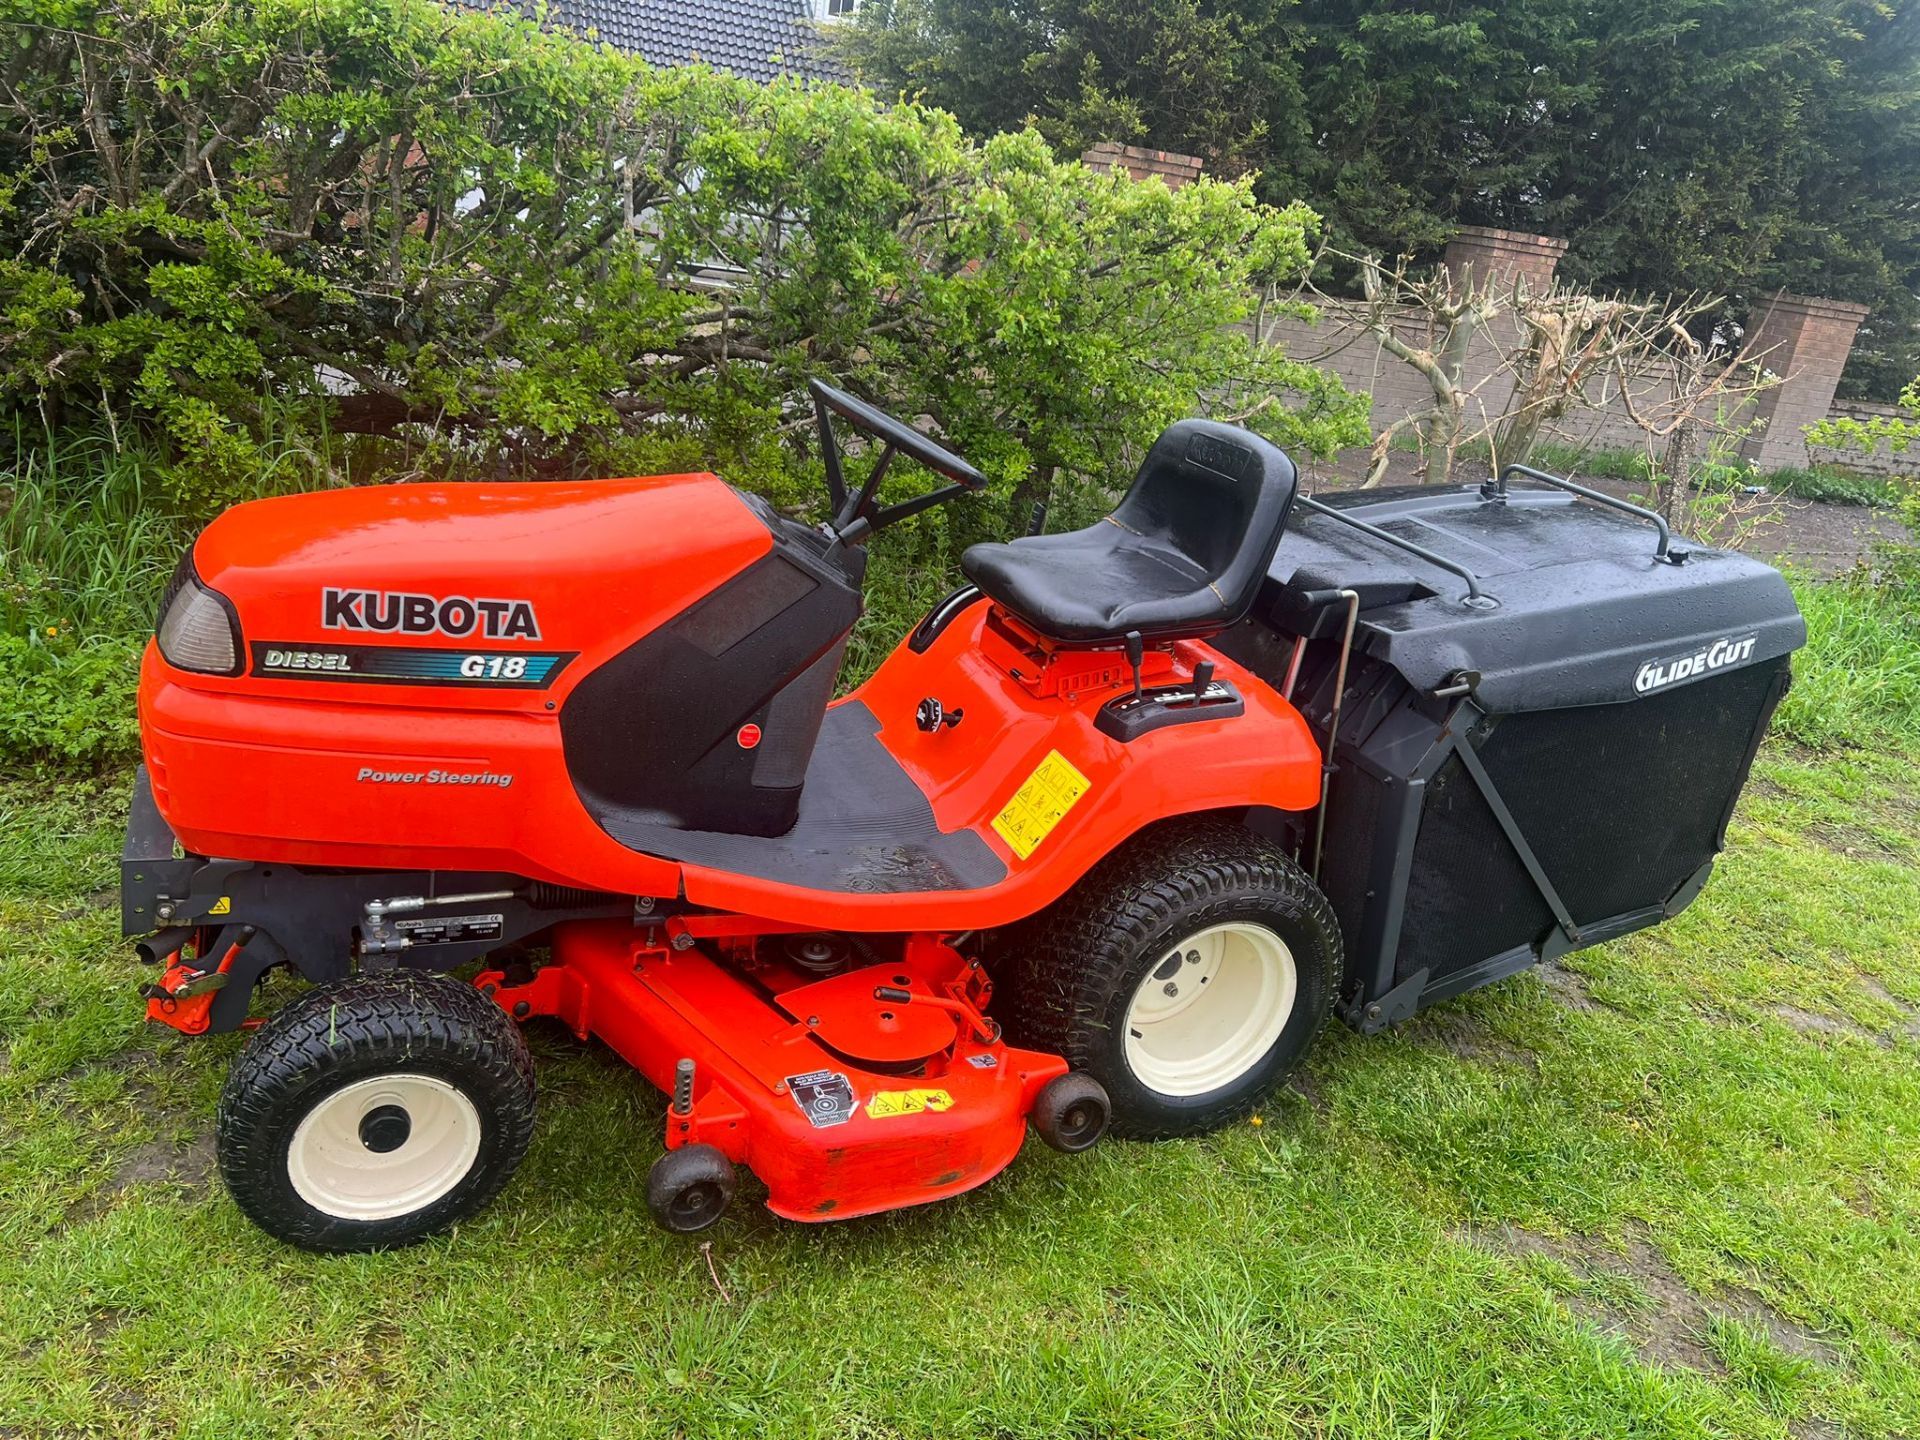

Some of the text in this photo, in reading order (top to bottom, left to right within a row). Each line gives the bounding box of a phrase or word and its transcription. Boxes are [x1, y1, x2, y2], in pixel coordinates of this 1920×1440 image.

[321, 587, 543, 641] KUBOTA
[263, 649, 528, 679] DIESEL G18
